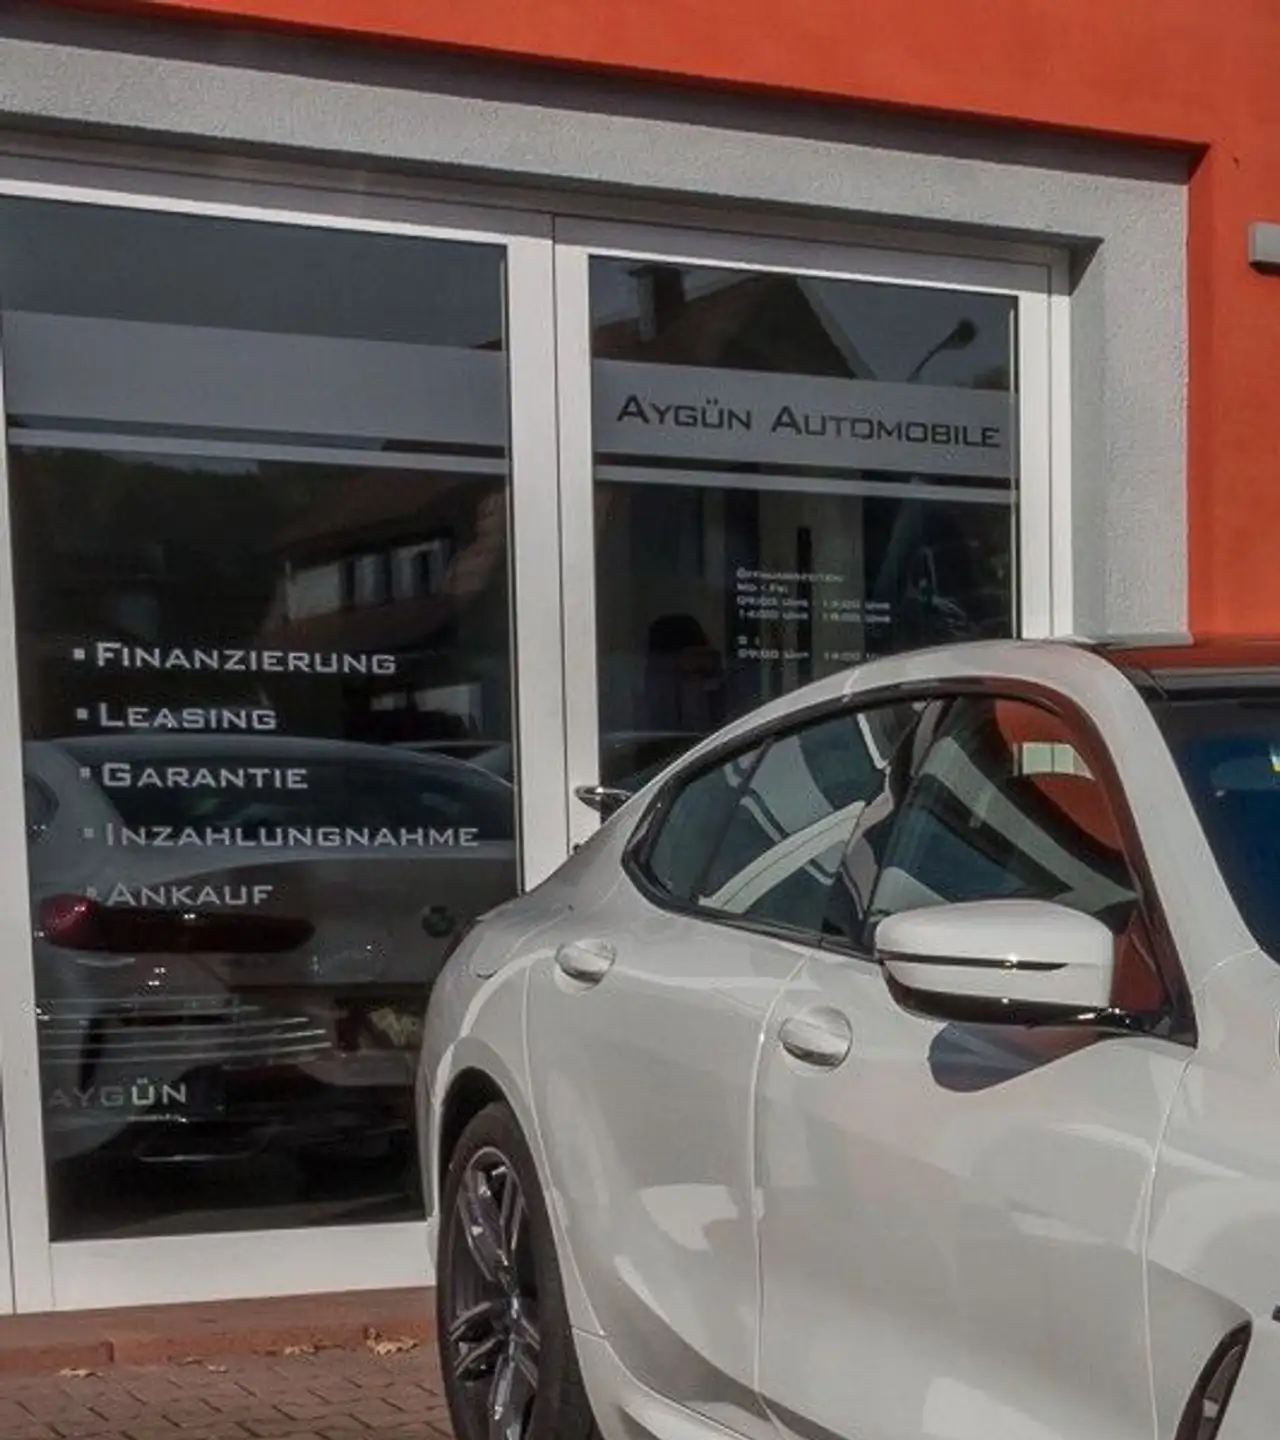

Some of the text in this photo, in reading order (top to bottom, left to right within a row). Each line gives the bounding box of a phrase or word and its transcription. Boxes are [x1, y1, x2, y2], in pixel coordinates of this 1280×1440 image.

[617, 394, 1000, 448] AYGÜN AUTOMOBILE
[96, 642, 396, 675] FINANZIERUNG
[100, 702, 278, 731] LEASING
[102, 763, 309, 790] GARANTIE
[105, 822, 480, 848] INZAHLUNGNAHME
[105, 882, 273, 906] ANKAUF
[51, 1077, 187, 1108] AYGÜN
